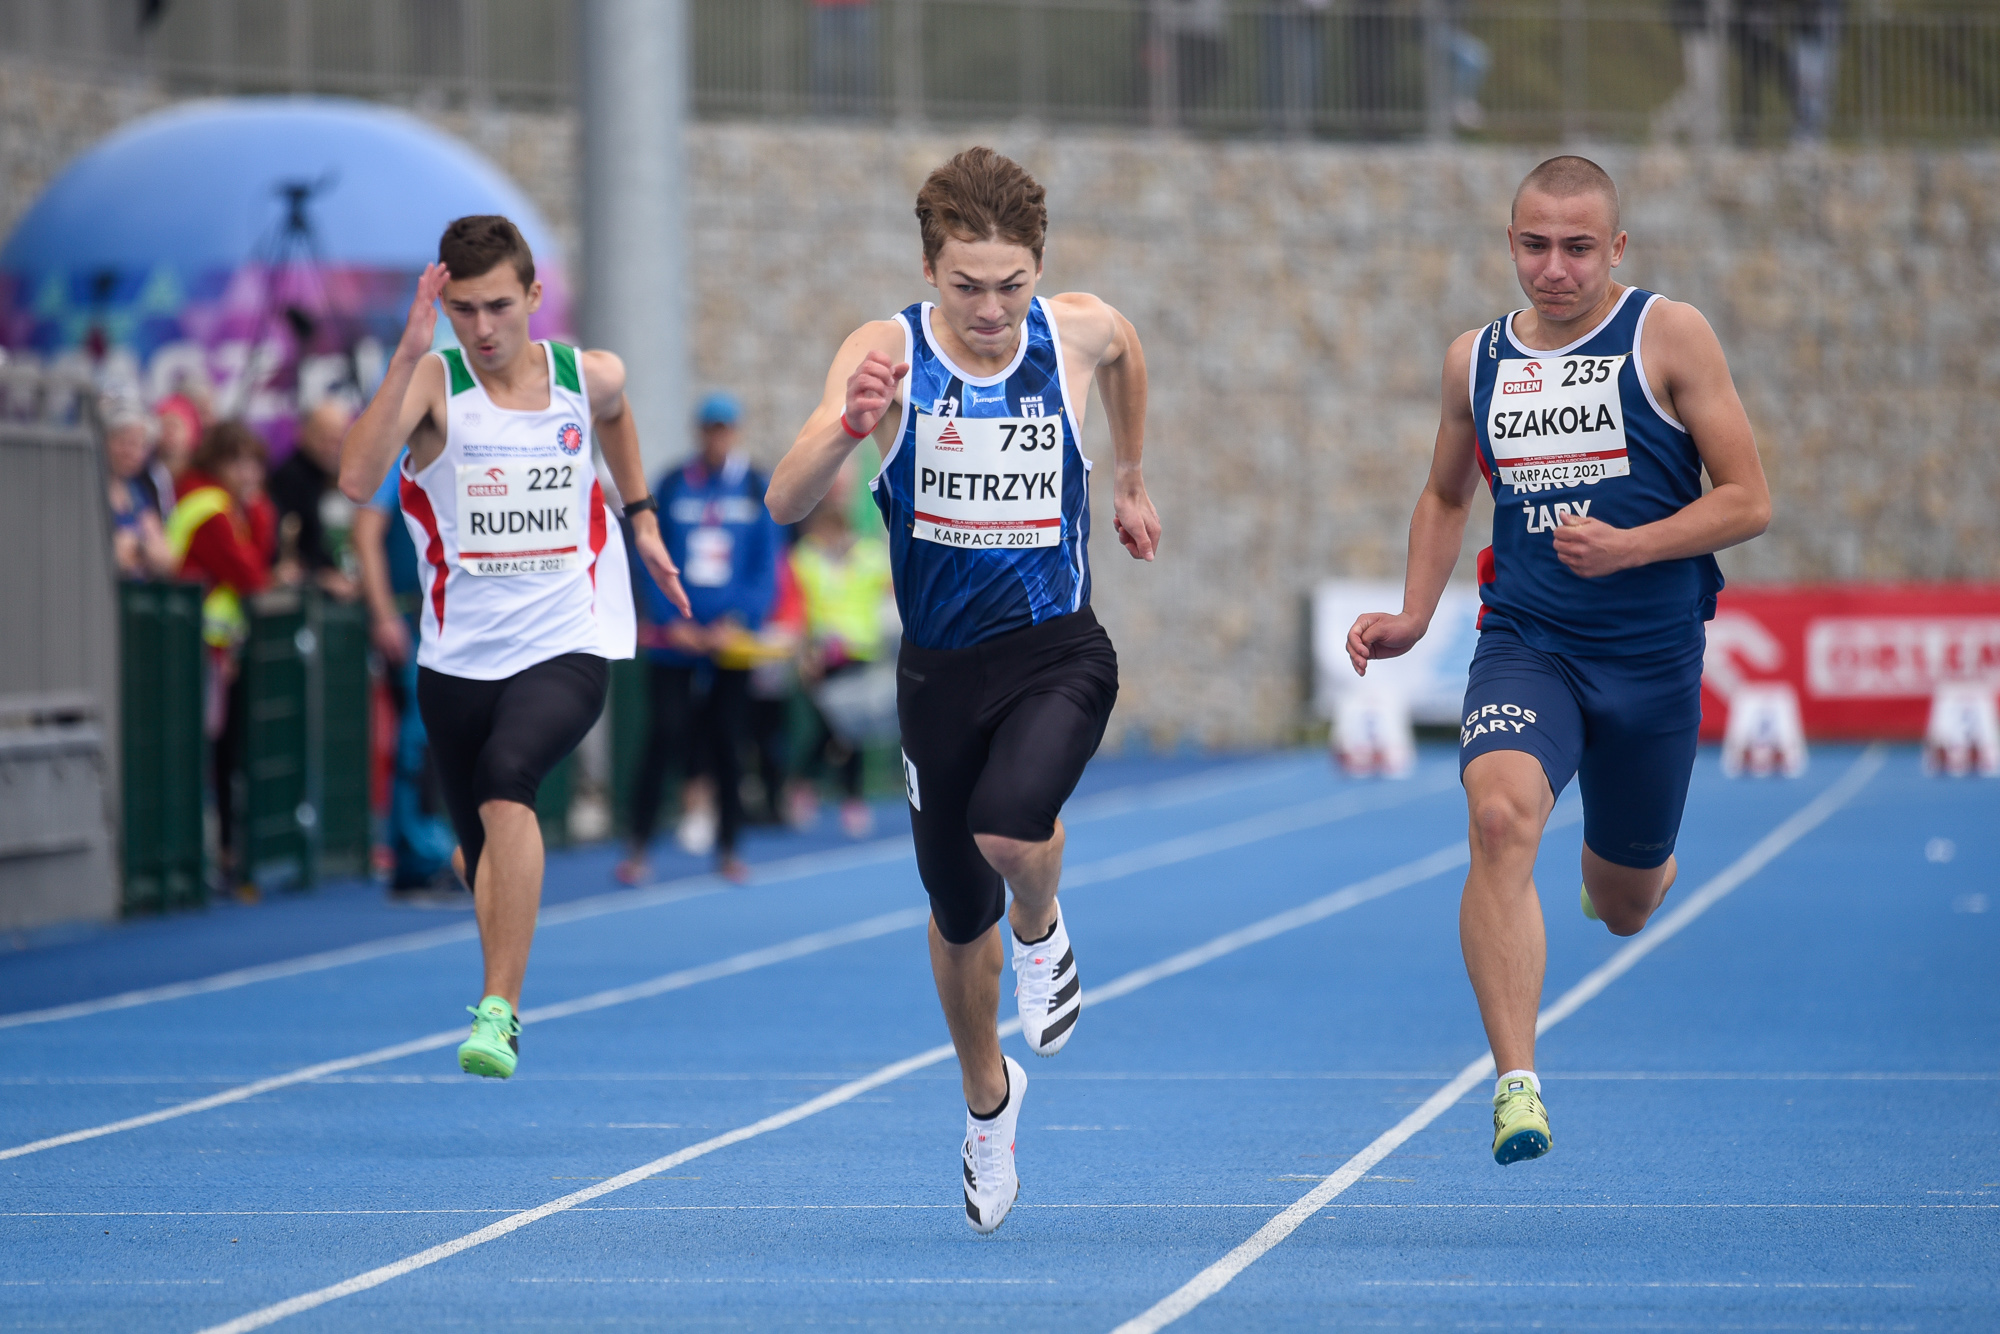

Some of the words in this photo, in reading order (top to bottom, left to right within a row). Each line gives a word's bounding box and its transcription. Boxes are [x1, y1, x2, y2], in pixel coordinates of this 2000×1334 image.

[1561, 359, 1614, 387] 235
[1504, 382, 1541, 393] ORLEN
[972, 391, 1005, 408] jumper
[1031, 408, 1036, 416] 3
[1494, 403, 1616, 440] SZAKOŁA
[999, 423, 1056, 452] 733
[935, 445, 964, 453] KARPACZ
[527, 465, 572, 491] 222
[1512, 467, 1570, 483] KARPACZ
[1573, 463, 1606, 478] 2021
[469, 486, 506, 496] ORLEN
[921, 467, 1057, 501] PIETRZYK
[470, 507, 568, 535] RUDNIK
[934, 527, 1003, 546] KARPACZ
[1007, 532, 1040, 545] 2021
[478, 561, 535, 574] KARPACZ
[540, 558, 566, 571] 2021
